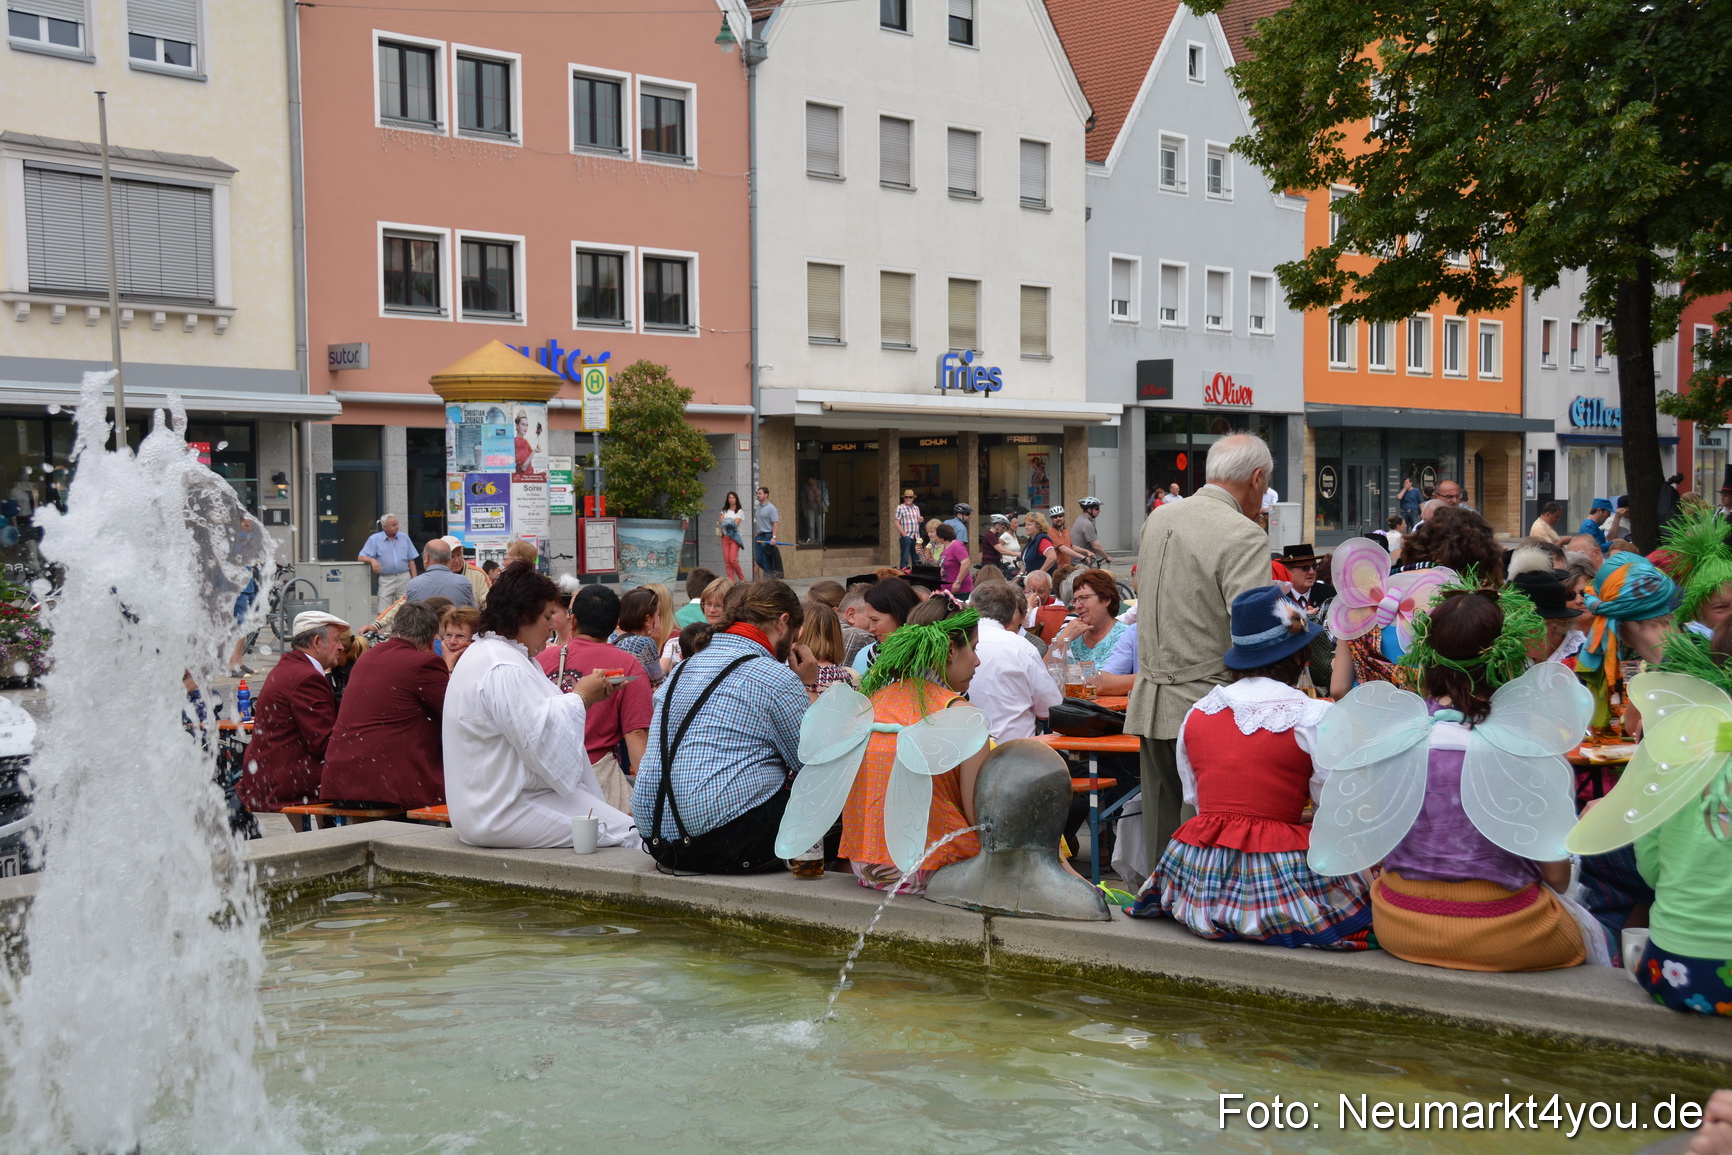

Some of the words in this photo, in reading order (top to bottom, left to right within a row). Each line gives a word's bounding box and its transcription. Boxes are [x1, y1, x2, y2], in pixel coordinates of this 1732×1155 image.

[590, 374, 600, 389] H
[1204, 372, 1254, 405] s.Oliver
[919, 439, 947, 447] SCHUH
[1006, 435, 1037, 443] FRIES
[831, 443, 857, 451] SCHUH
[864, 442, 879, 450] FRIE
[523, 484, 543, 492] Soiree
